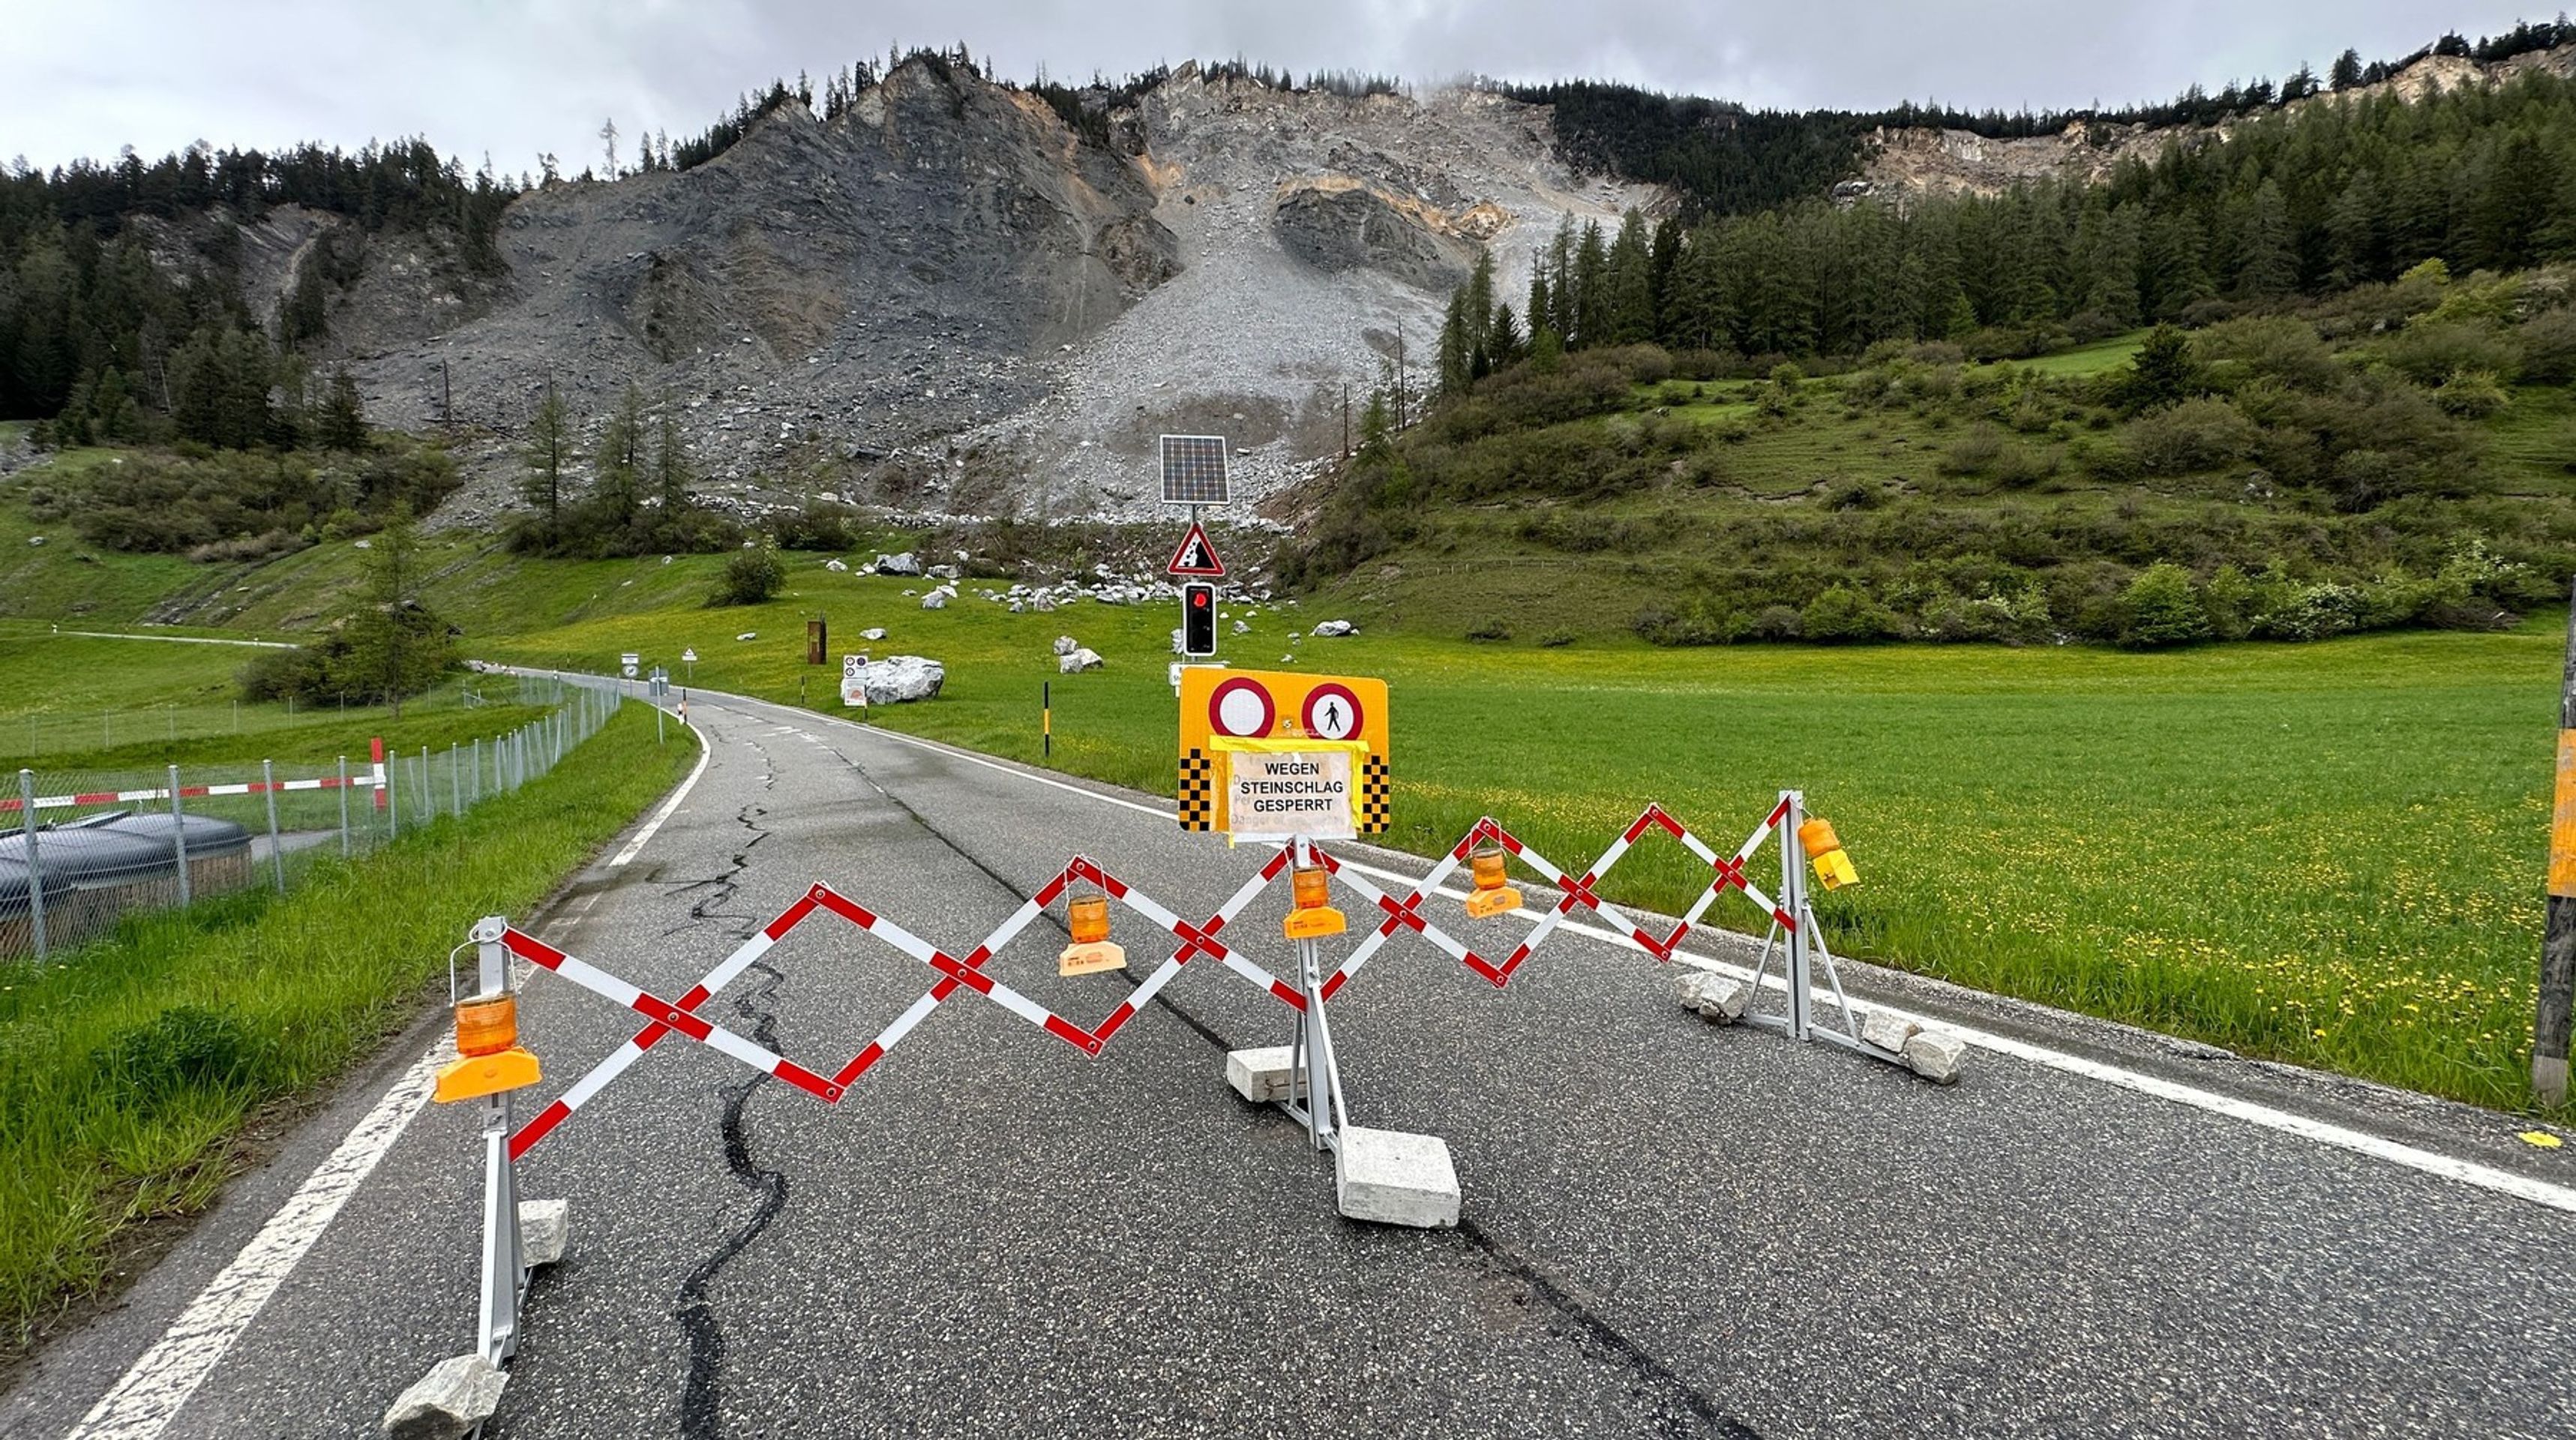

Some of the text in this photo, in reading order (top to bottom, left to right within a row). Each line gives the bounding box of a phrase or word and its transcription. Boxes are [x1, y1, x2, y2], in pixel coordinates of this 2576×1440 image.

[1264, 762, 1320, 776] WEGEN
[1240, 781, 1344, 795] STEINSCHLAG
[1253, 798, 1333, 812] GESPERRT
